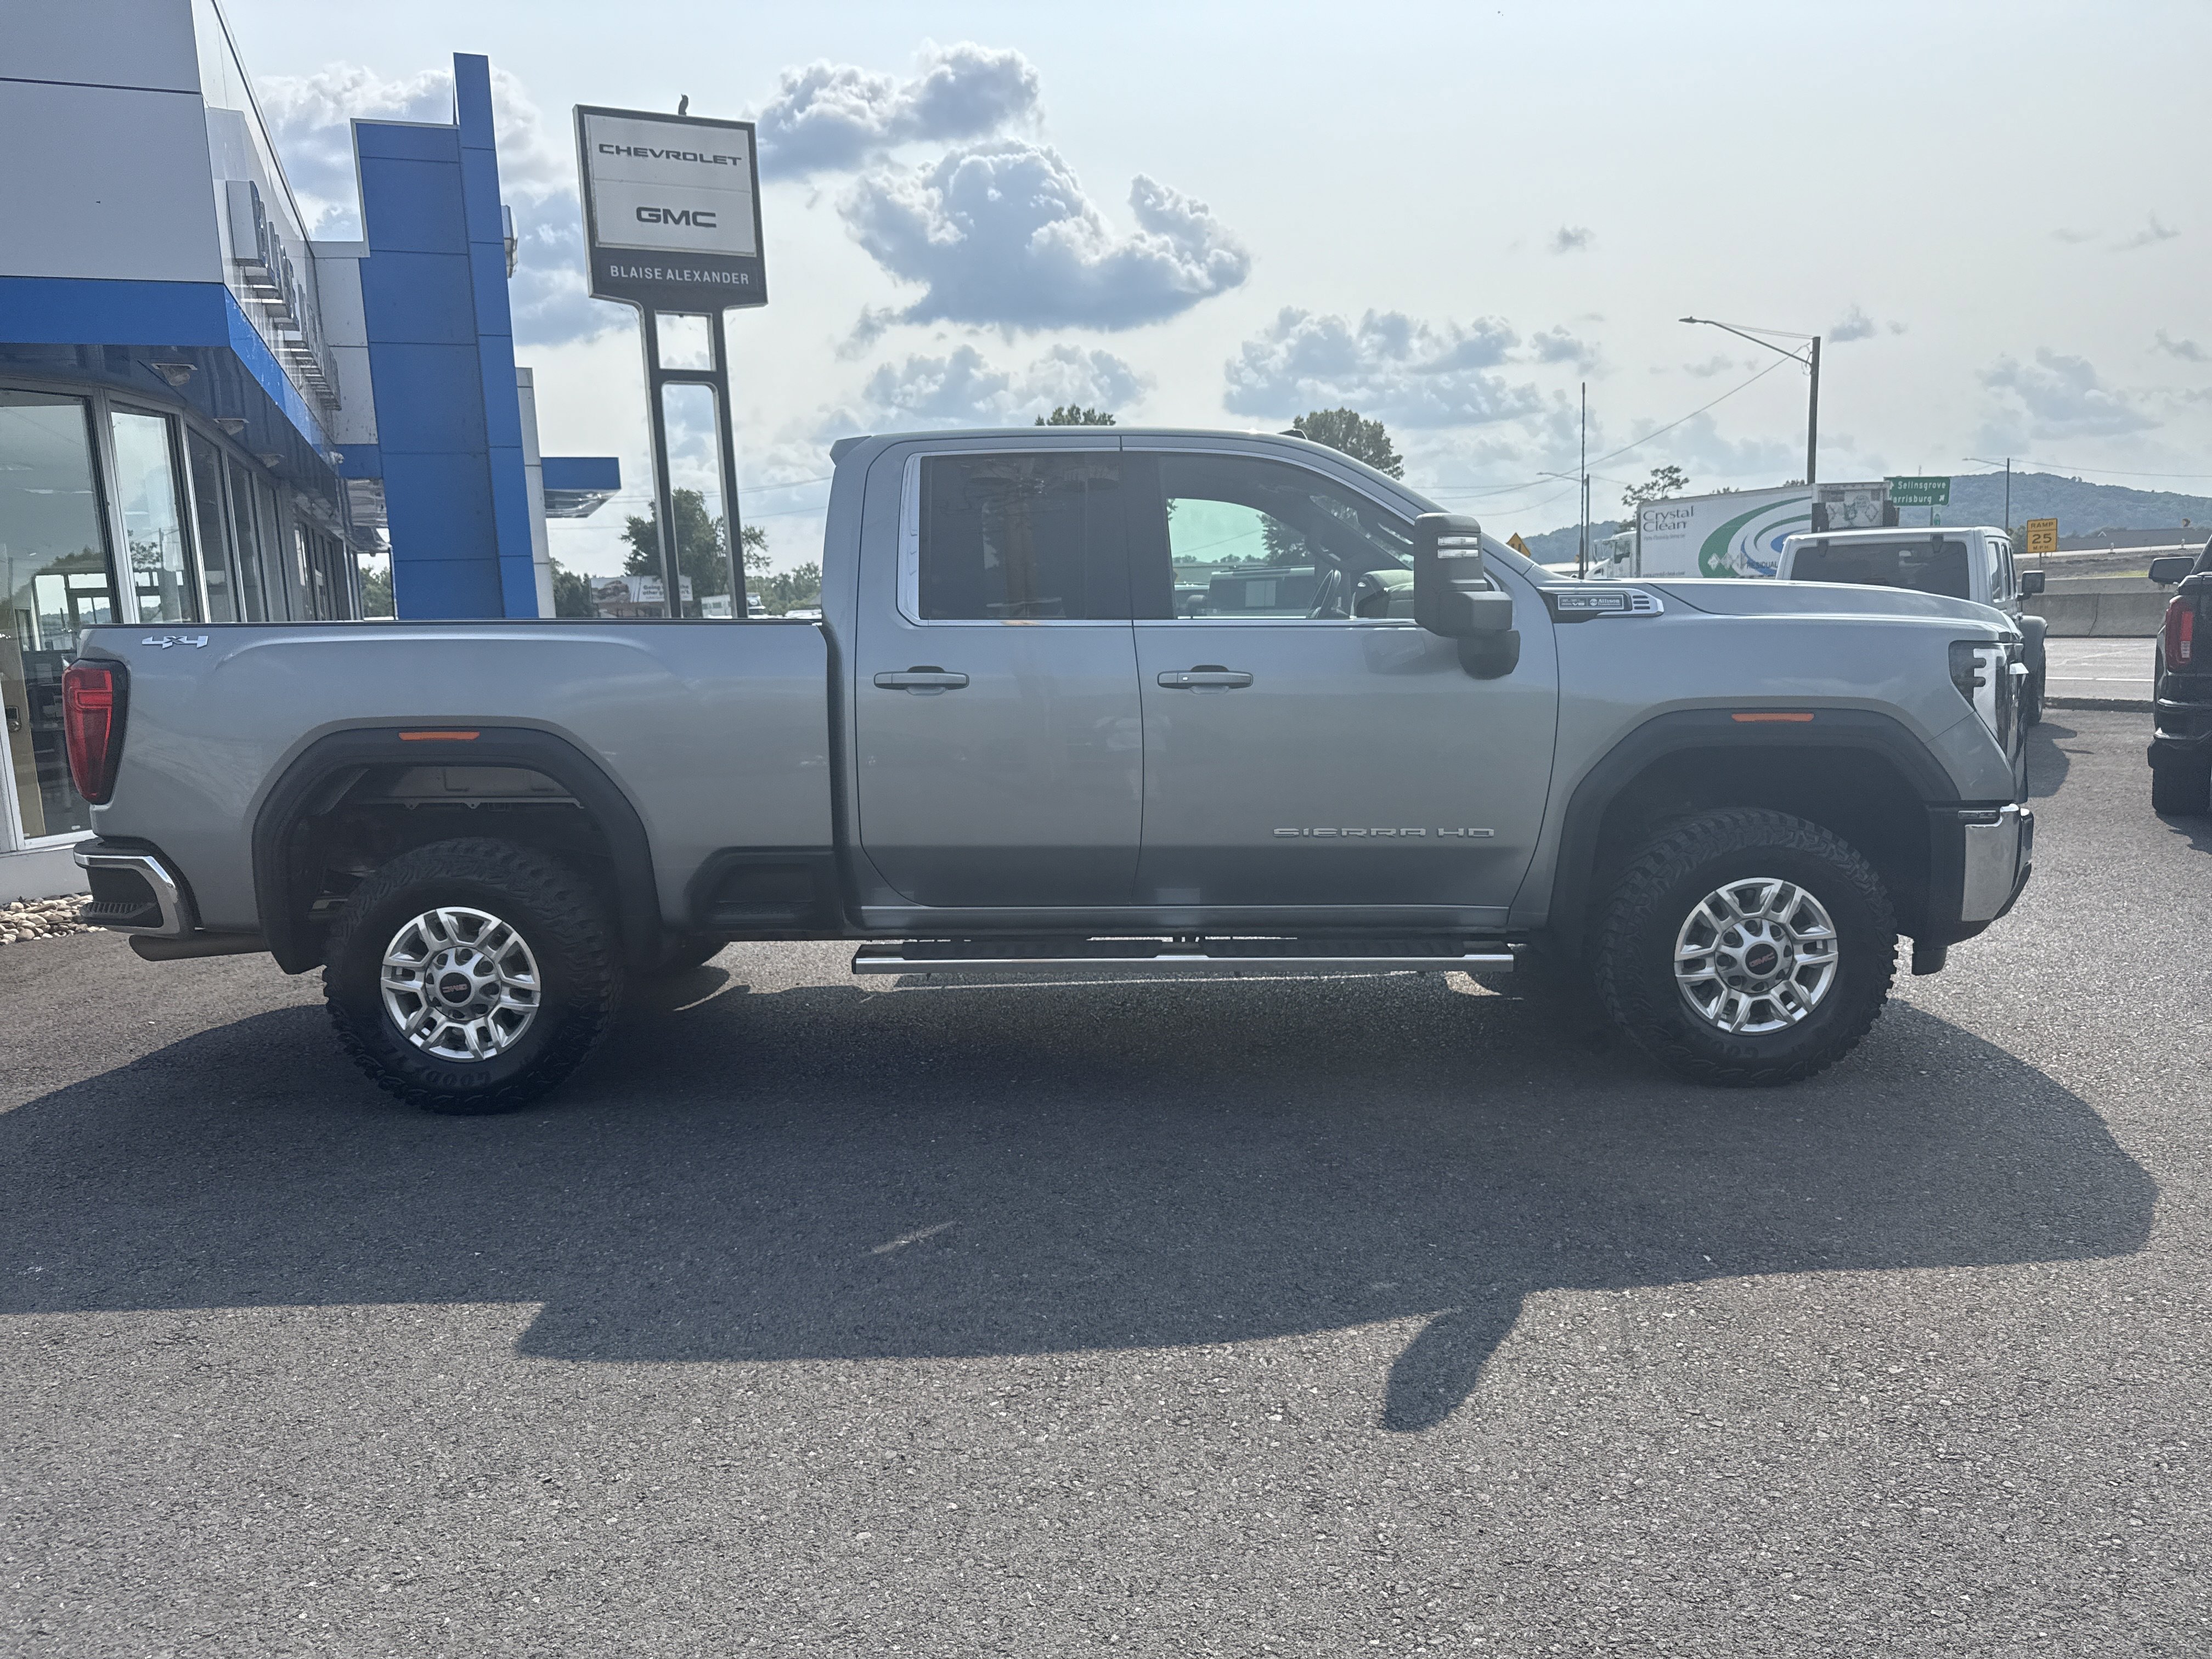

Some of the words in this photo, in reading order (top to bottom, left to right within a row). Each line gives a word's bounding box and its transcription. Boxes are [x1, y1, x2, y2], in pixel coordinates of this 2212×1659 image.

[599, 143, 742, 166] CHEVROLET
[636, 206, 716, 228] GMC
[610, 265, 662, 280] BLAISE
[667, 268, 749, 285] ALEXANDER
[1898, 481, 1946, 491] Selinsgrove
[1643, 505, 1694, 522] Crystal
[1643, 521, 1686, 532] Clean
[2032, 533, 2052, 544] 25
[1273, 828, 1426, 837] SIERRA
[1438, 828, 1494, 837] HD
[1749, 952, 1775, 967] GMC
